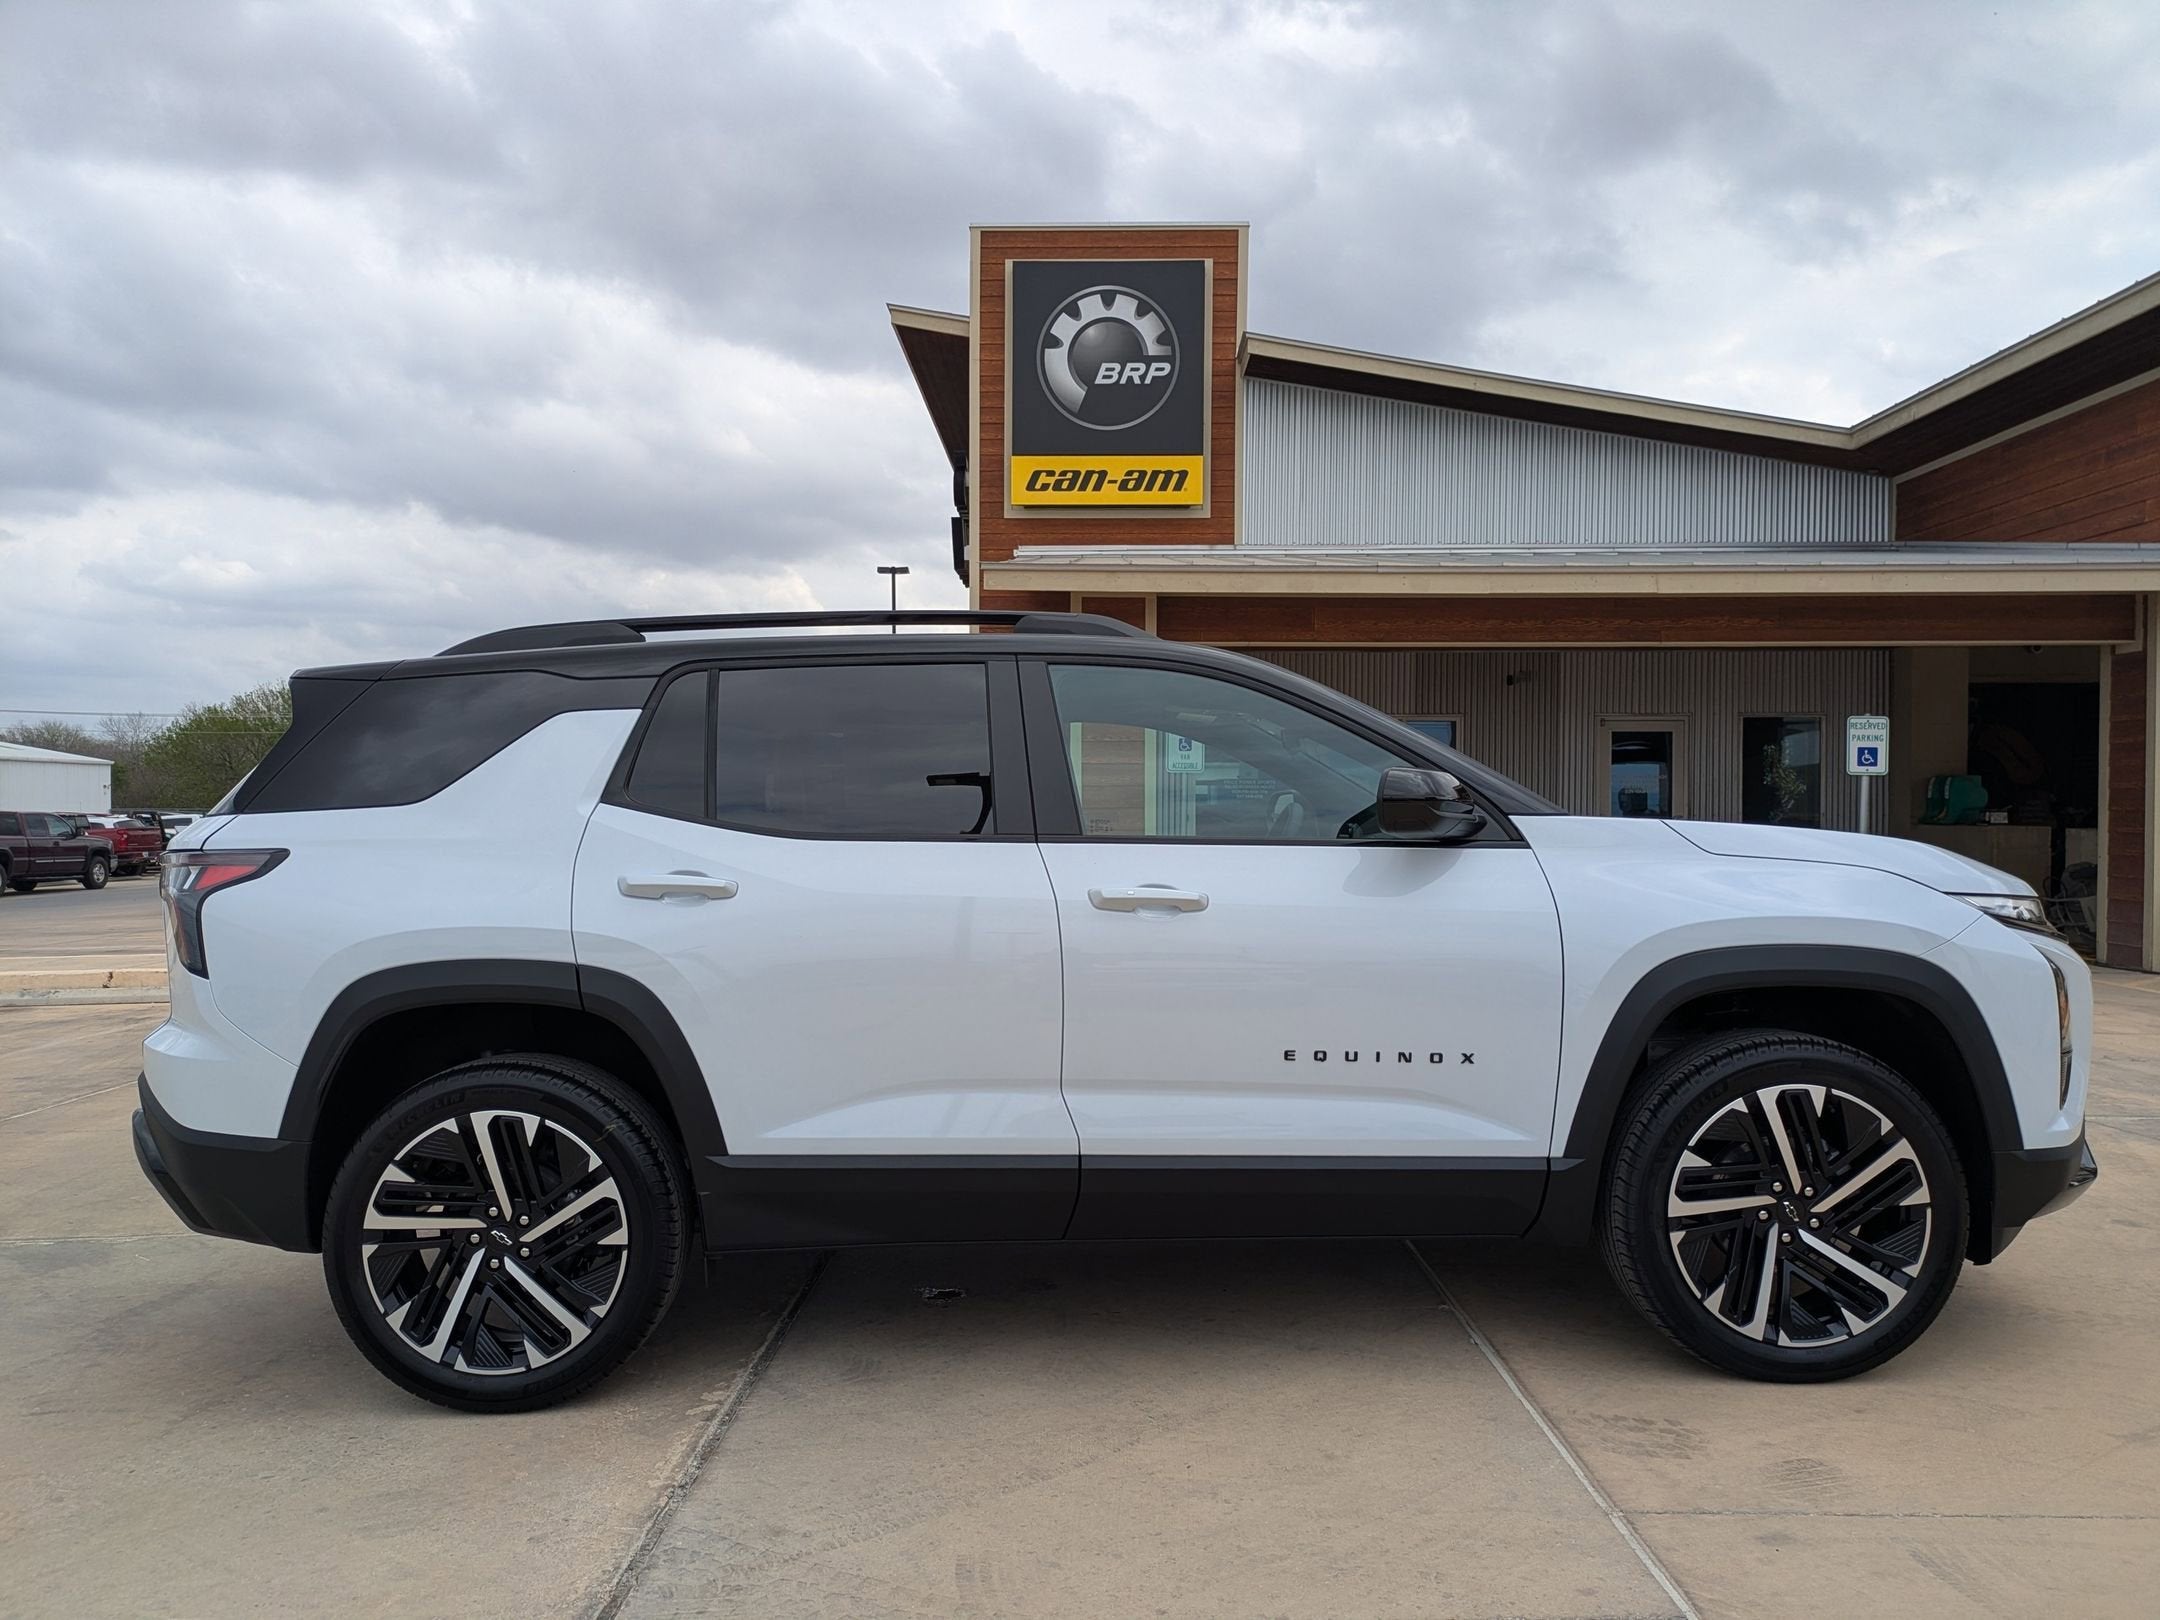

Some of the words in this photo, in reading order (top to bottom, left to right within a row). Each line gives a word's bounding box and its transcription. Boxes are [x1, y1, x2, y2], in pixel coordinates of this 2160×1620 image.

[1094, 362, 1172, 385] BRP
[1025, 468, 1189, 492] can-am
[1850, 722, 1886, 730] RESERVED
[1851, 734, 1885, 742] PARKING
[1283, 1049, 1475, 1065] EQUINOX
